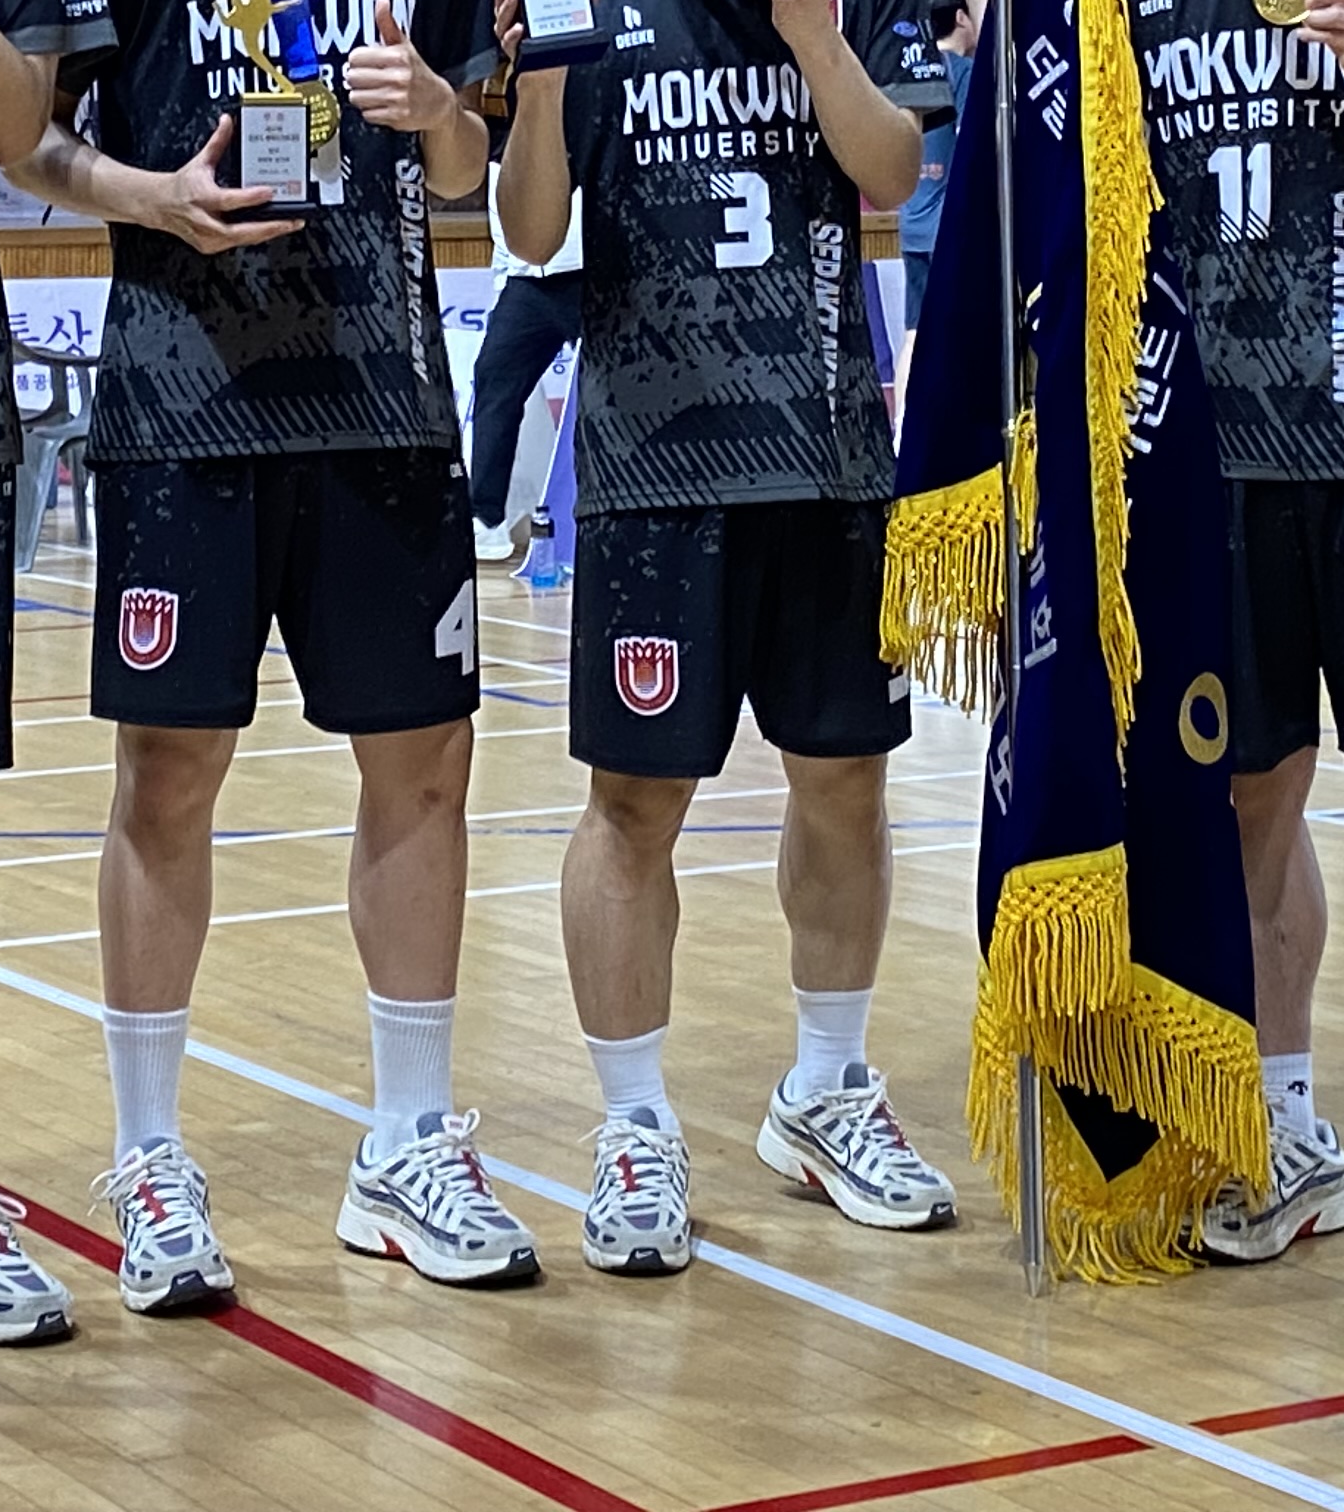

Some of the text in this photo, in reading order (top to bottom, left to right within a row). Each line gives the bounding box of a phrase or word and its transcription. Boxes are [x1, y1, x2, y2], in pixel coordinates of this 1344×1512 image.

[710, 171, 775, 269] 3
[1207, 143, 1272, 243] 11
[435, 578, 476, 677] 4
